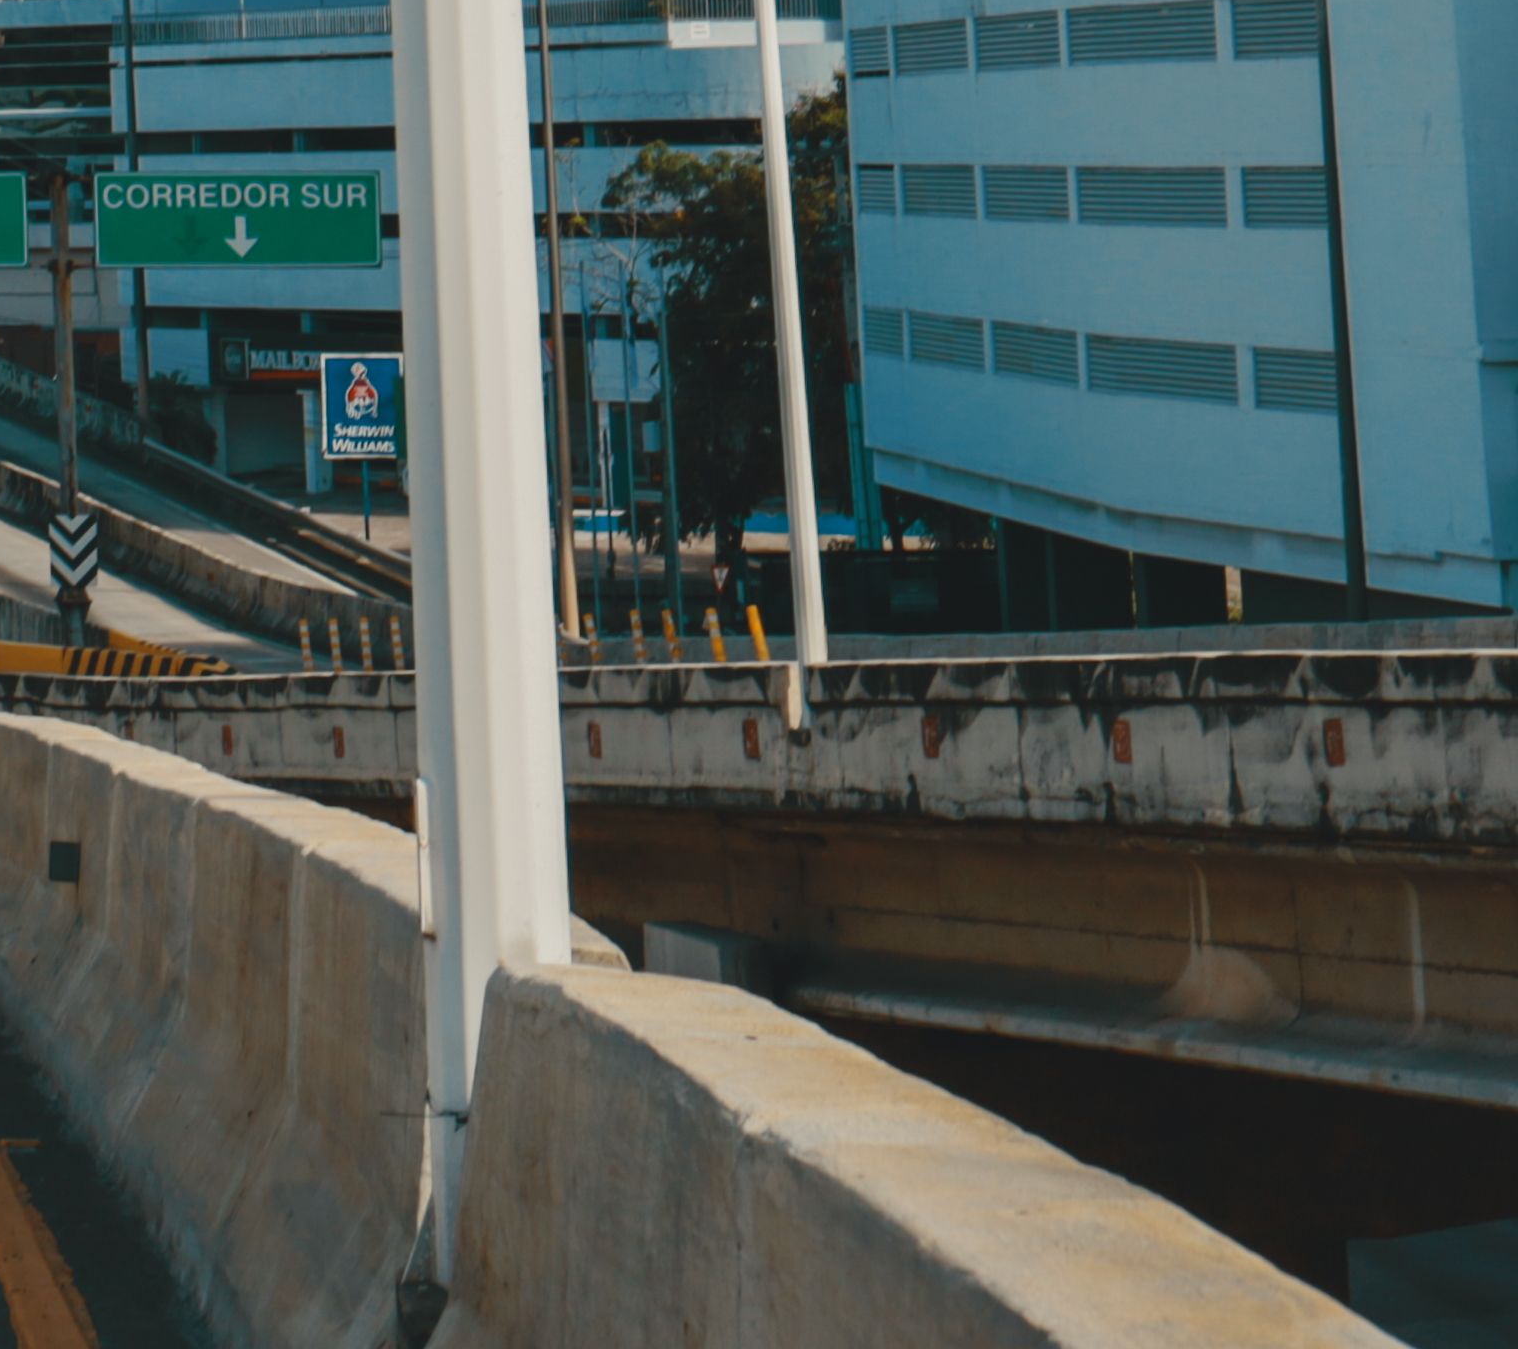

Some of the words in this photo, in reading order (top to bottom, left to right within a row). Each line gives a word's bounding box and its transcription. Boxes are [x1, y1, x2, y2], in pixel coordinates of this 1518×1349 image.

[102, 183, 290, 209] CORREDOR
[301, 183, 367, 209] SUR
[333, 423, 395, 437] SHERWIN
[332, 439, 395, 453] WILLIAMS
